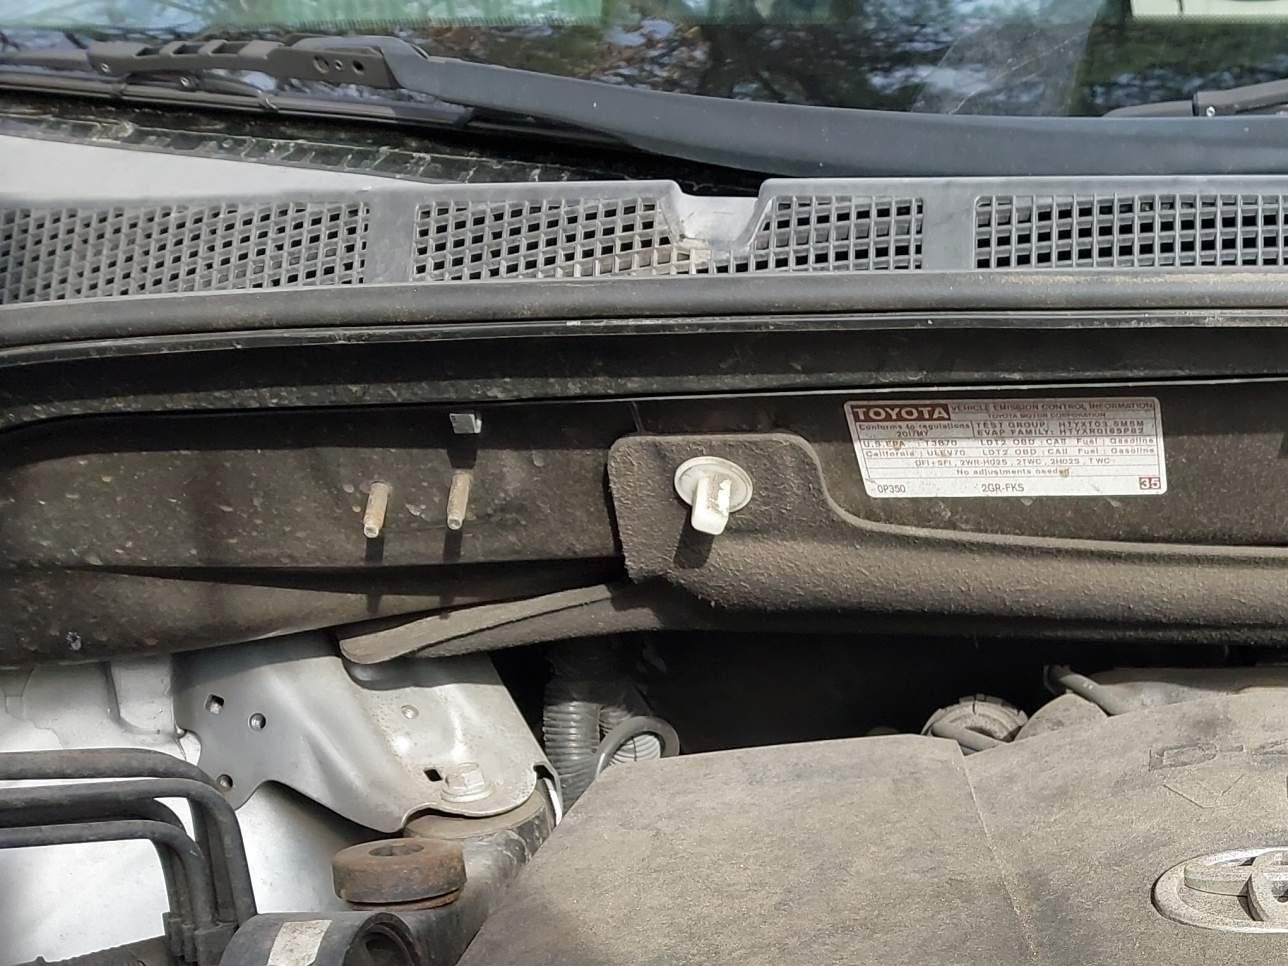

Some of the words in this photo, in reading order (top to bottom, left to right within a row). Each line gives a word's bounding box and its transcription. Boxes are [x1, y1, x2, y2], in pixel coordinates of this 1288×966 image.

[951, 403, 987, 411] VEHICLE
[993, 402, 1039, 411] EMISSION
[1041, 402, 1087, 410] CONTROL
[1089, 402, 1153, 410] INFORMATION
[853, 406, 949, 420] TOYOTA
[858, 423, 905, 431] Conforms
[918, 423, 970, 432] regulations
[981, 483, 1025, 492] 2GR-FKS
[1140, 477, 1160, 489] 35
